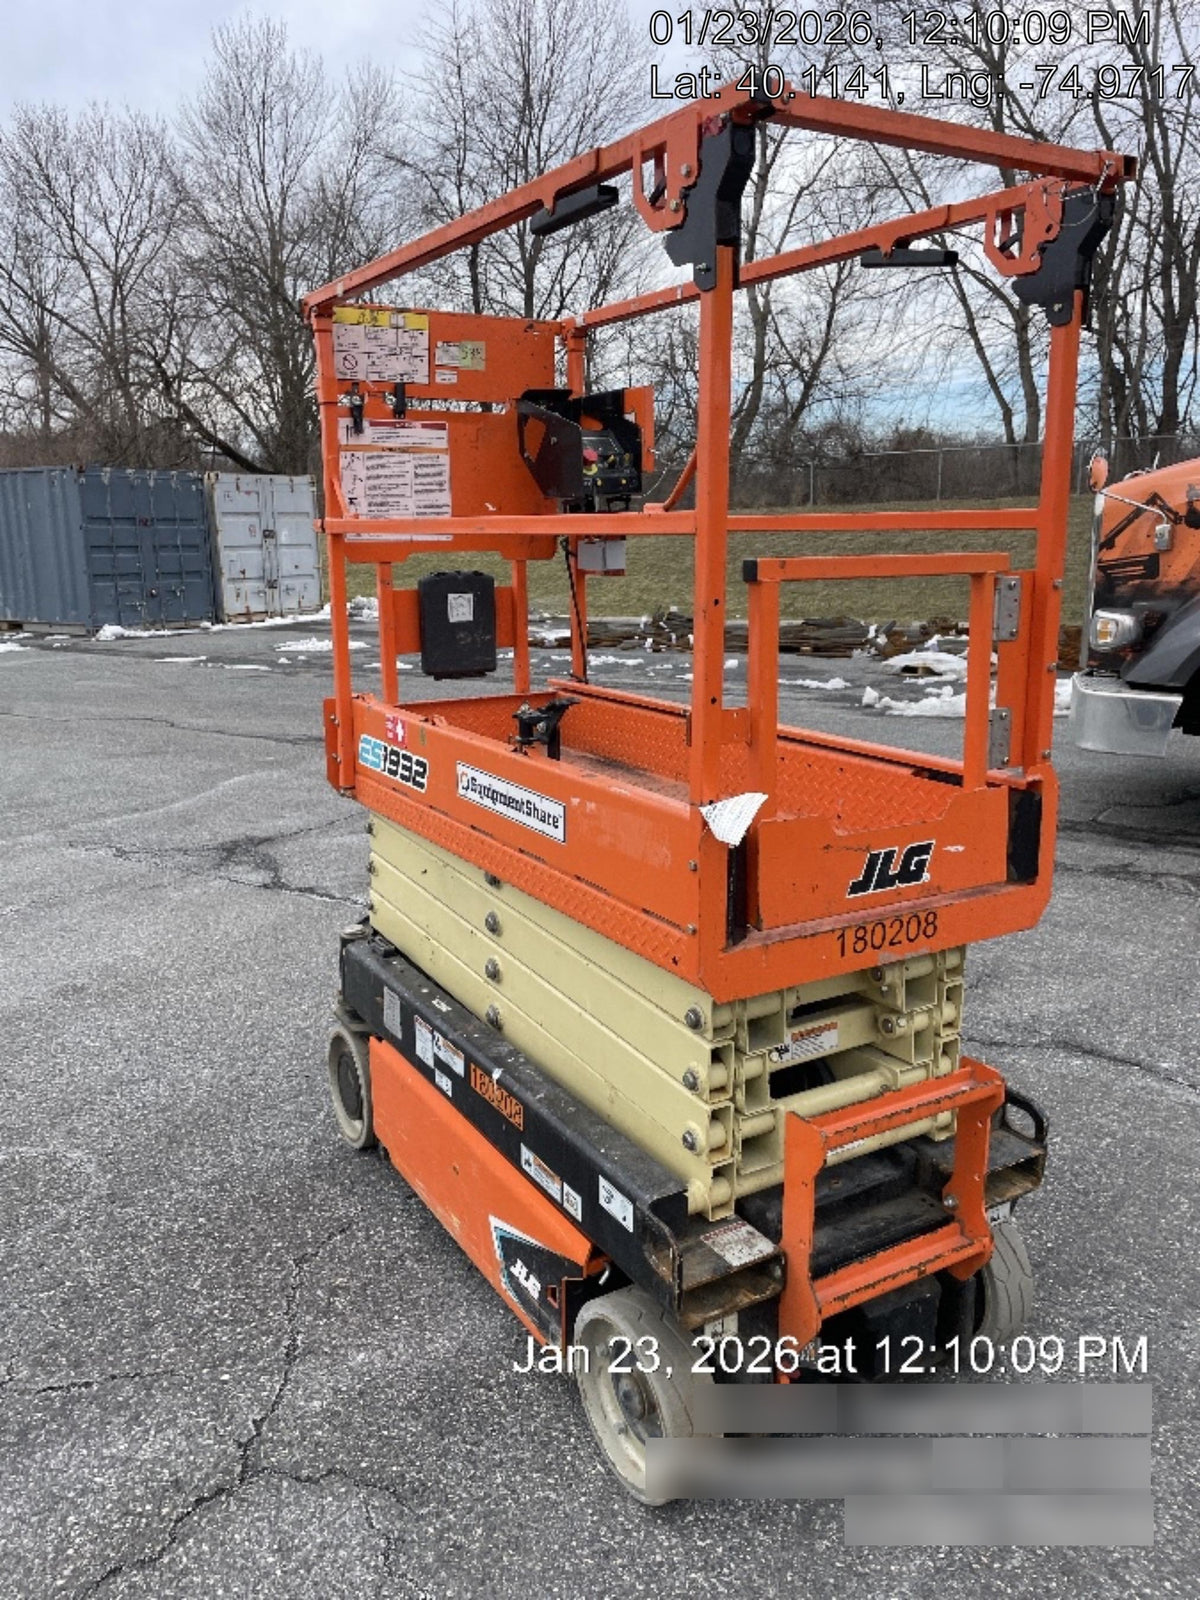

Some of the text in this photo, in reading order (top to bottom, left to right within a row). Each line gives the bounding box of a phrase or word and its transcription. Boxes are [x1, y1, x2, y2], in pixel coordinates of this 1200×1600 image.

[359, 735, 428, 792] ES1932
[470, 776, 559, 829] EquipmentShare
[846, 840, 936, 898] JLG
[836, 911, 938, 958] 180208
